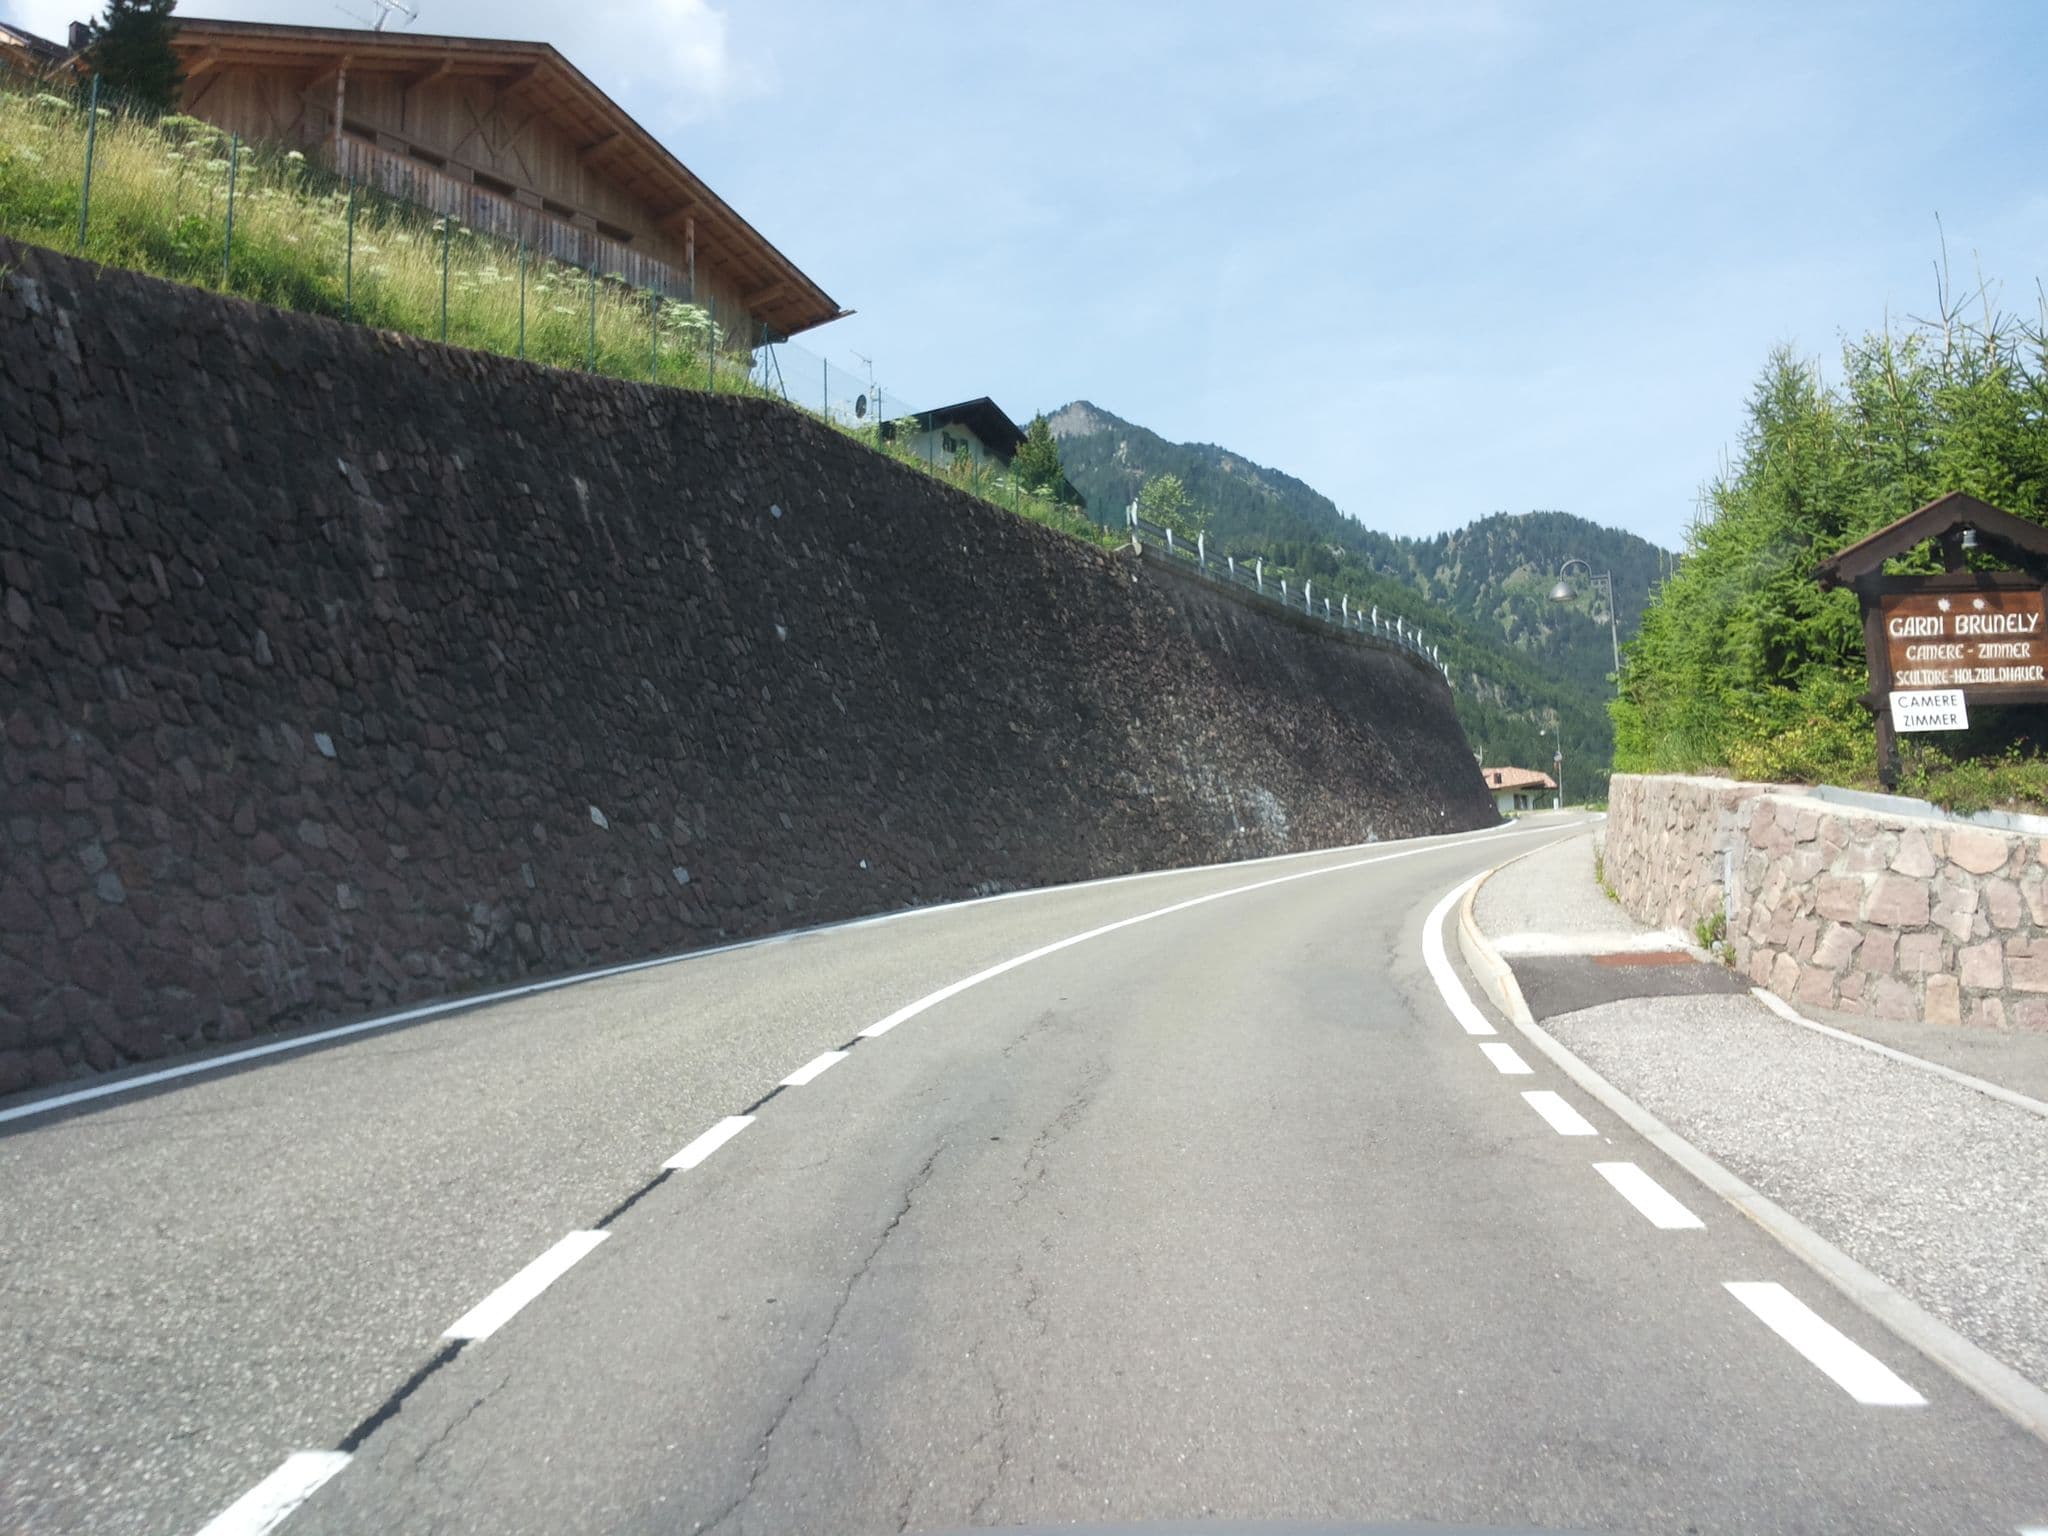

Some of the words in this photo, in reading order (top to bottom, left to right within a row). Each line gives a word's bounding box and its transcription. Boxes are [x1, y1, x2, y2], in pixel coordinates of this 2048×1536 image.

[1889, 616, 1944, 637] GARNI
[1955, 612, 2039, 635] BRUNELY
[1906, 643, 1964, 661] CAMERE
[1978, 642, 2031, 659] ZIMMER
[1898, 695, 1958, 708] CAMERE
[1903, 713, 1958, 727] ZIMMER
